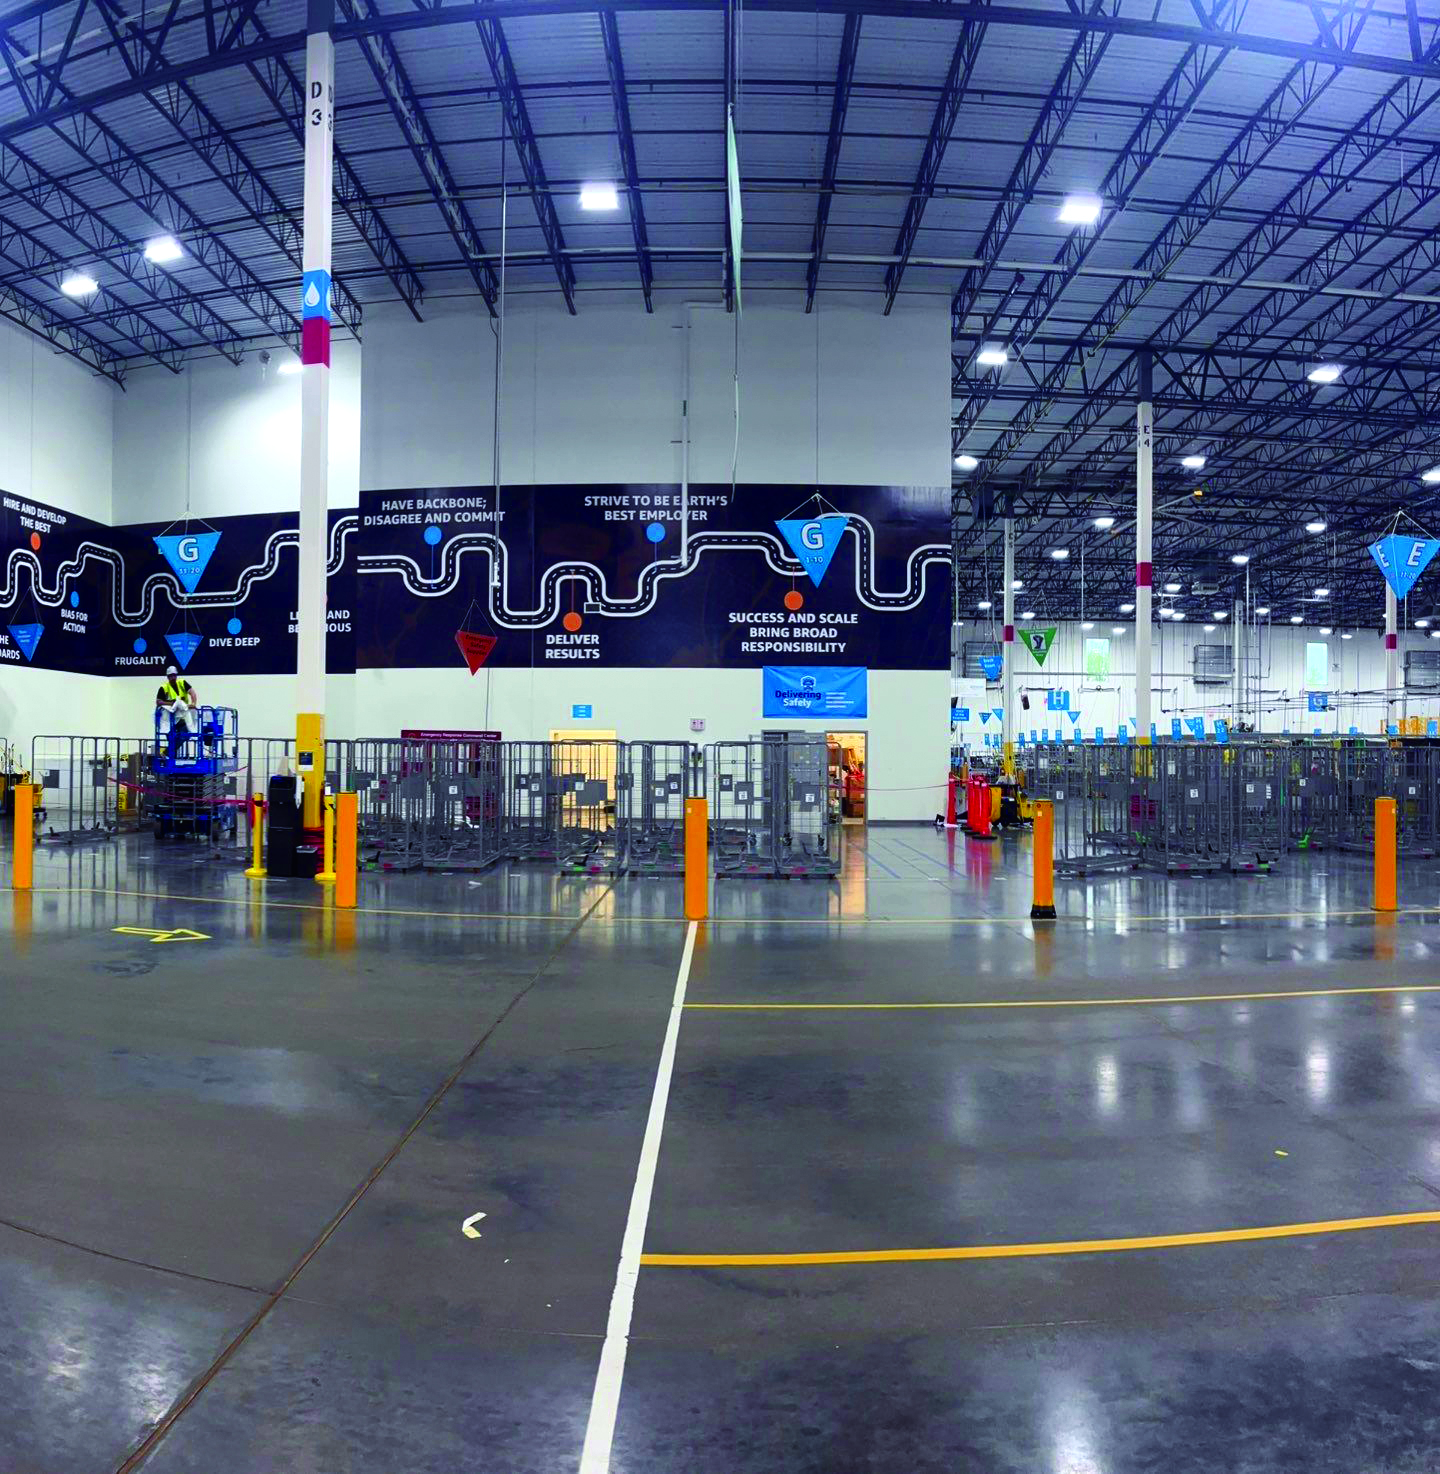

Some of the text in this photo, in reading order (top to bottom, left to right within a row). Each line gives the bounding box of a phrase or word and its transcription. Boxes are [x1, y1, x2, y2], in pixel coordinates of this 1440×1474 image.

[311, 82, 322, 98] D
[311, 109, 322, 125] 3
[382, 497, 486, 511] HAVE BACKBONE;
[584, 495, 728, 506] STRIVE TO BE ERTH'S
[3, 497, 67, 525] HIRE AND DEVELOP
[604, 510, 636, 520] BEST
[20, 515, 51, 533] THE BEST
[364, 511, 505, 526] DISAGREE AND COMMIT
[802, 522, 823, 549] G
[178, 537, 199, 562] G
[1407, 542, 1426, 566] E
[1376, 545, 1389, 568] E
[61, 608, 88, 621] BIAS FOR
[326, 610, 350, 620] AND
[729, 613, 857, 624] SUCCESS AND SCALE
[63, 621, 86, 634] ACTION
[288, 624, 300, 633] BE
[749, 628, 837, 638] BRING BROAD
[209, 637, 233, 647] DIVE
[235, 636, 259, 647] DEEP
[546, 635, 599, 644] DELIVER
[741, 641, 846, 653] RESPONSIBILITY
[545, 649, 600, 659] RESULTS
[114, 656, 166, 665] FRUGALITY
[775, 691, 821, 700] Delivering
[783, 698, 811, 708] Safely
